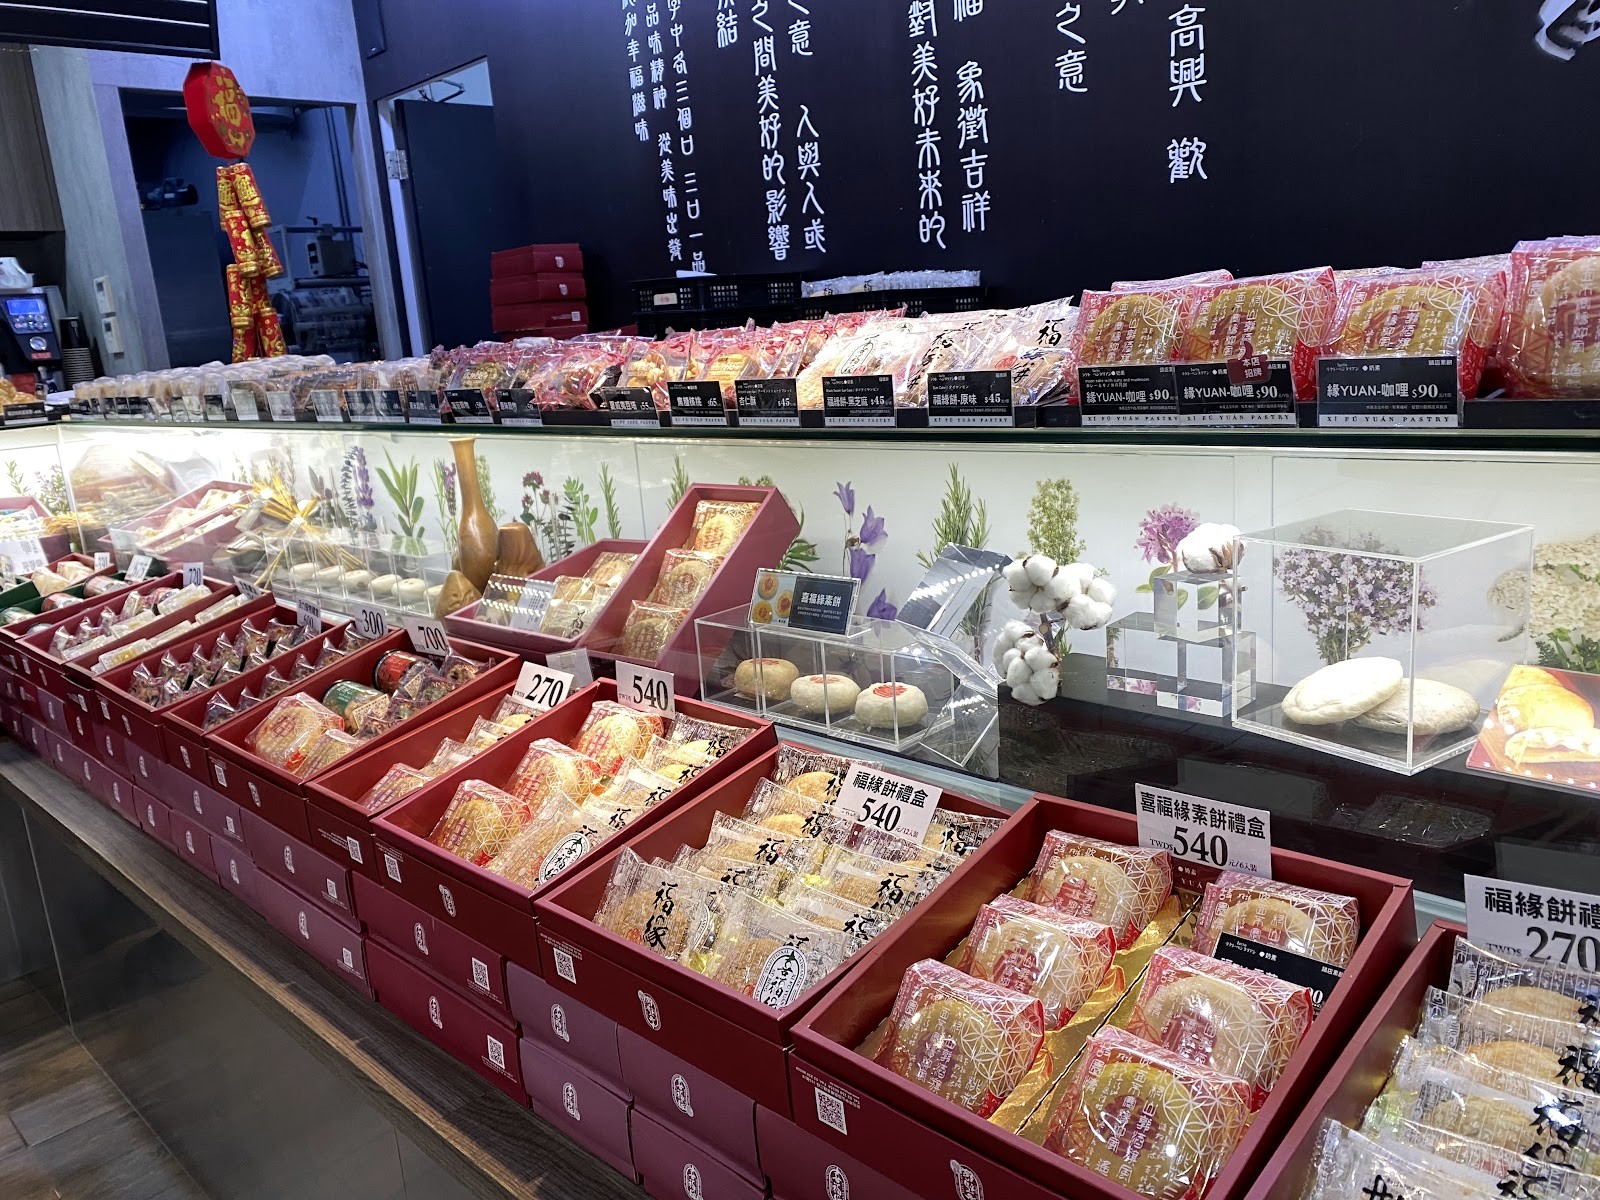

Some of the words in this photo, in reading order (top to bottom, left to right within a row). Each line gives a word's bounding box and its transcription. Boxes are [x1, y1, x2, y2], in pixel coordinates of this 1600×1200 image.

[1168, 4, 1208, 107] 高興
[956, 60, 991, 233] 象徵吉祥
[1166, 136, 1208, 184] 歡
[1149, 388, 1170, 401] $90
[1256, 386, 1278, 399] $90
[1411, 383, 1439, 399] $90
[361, 609, 384, 636] 300
[417, 625, 447, 651] 700
[525, 673, 564, 708] 270
[632, 674, 669, 711] 540
[852, 770, 929, 809] 福緣餅禮盒
[857, 797, 902, 832] 540
[1140, 790, 1266, 840] 喜福緣素餅禮盒
[1173, 825, 1229, 867] 540
[1526, 926, 1600, 975] 270
